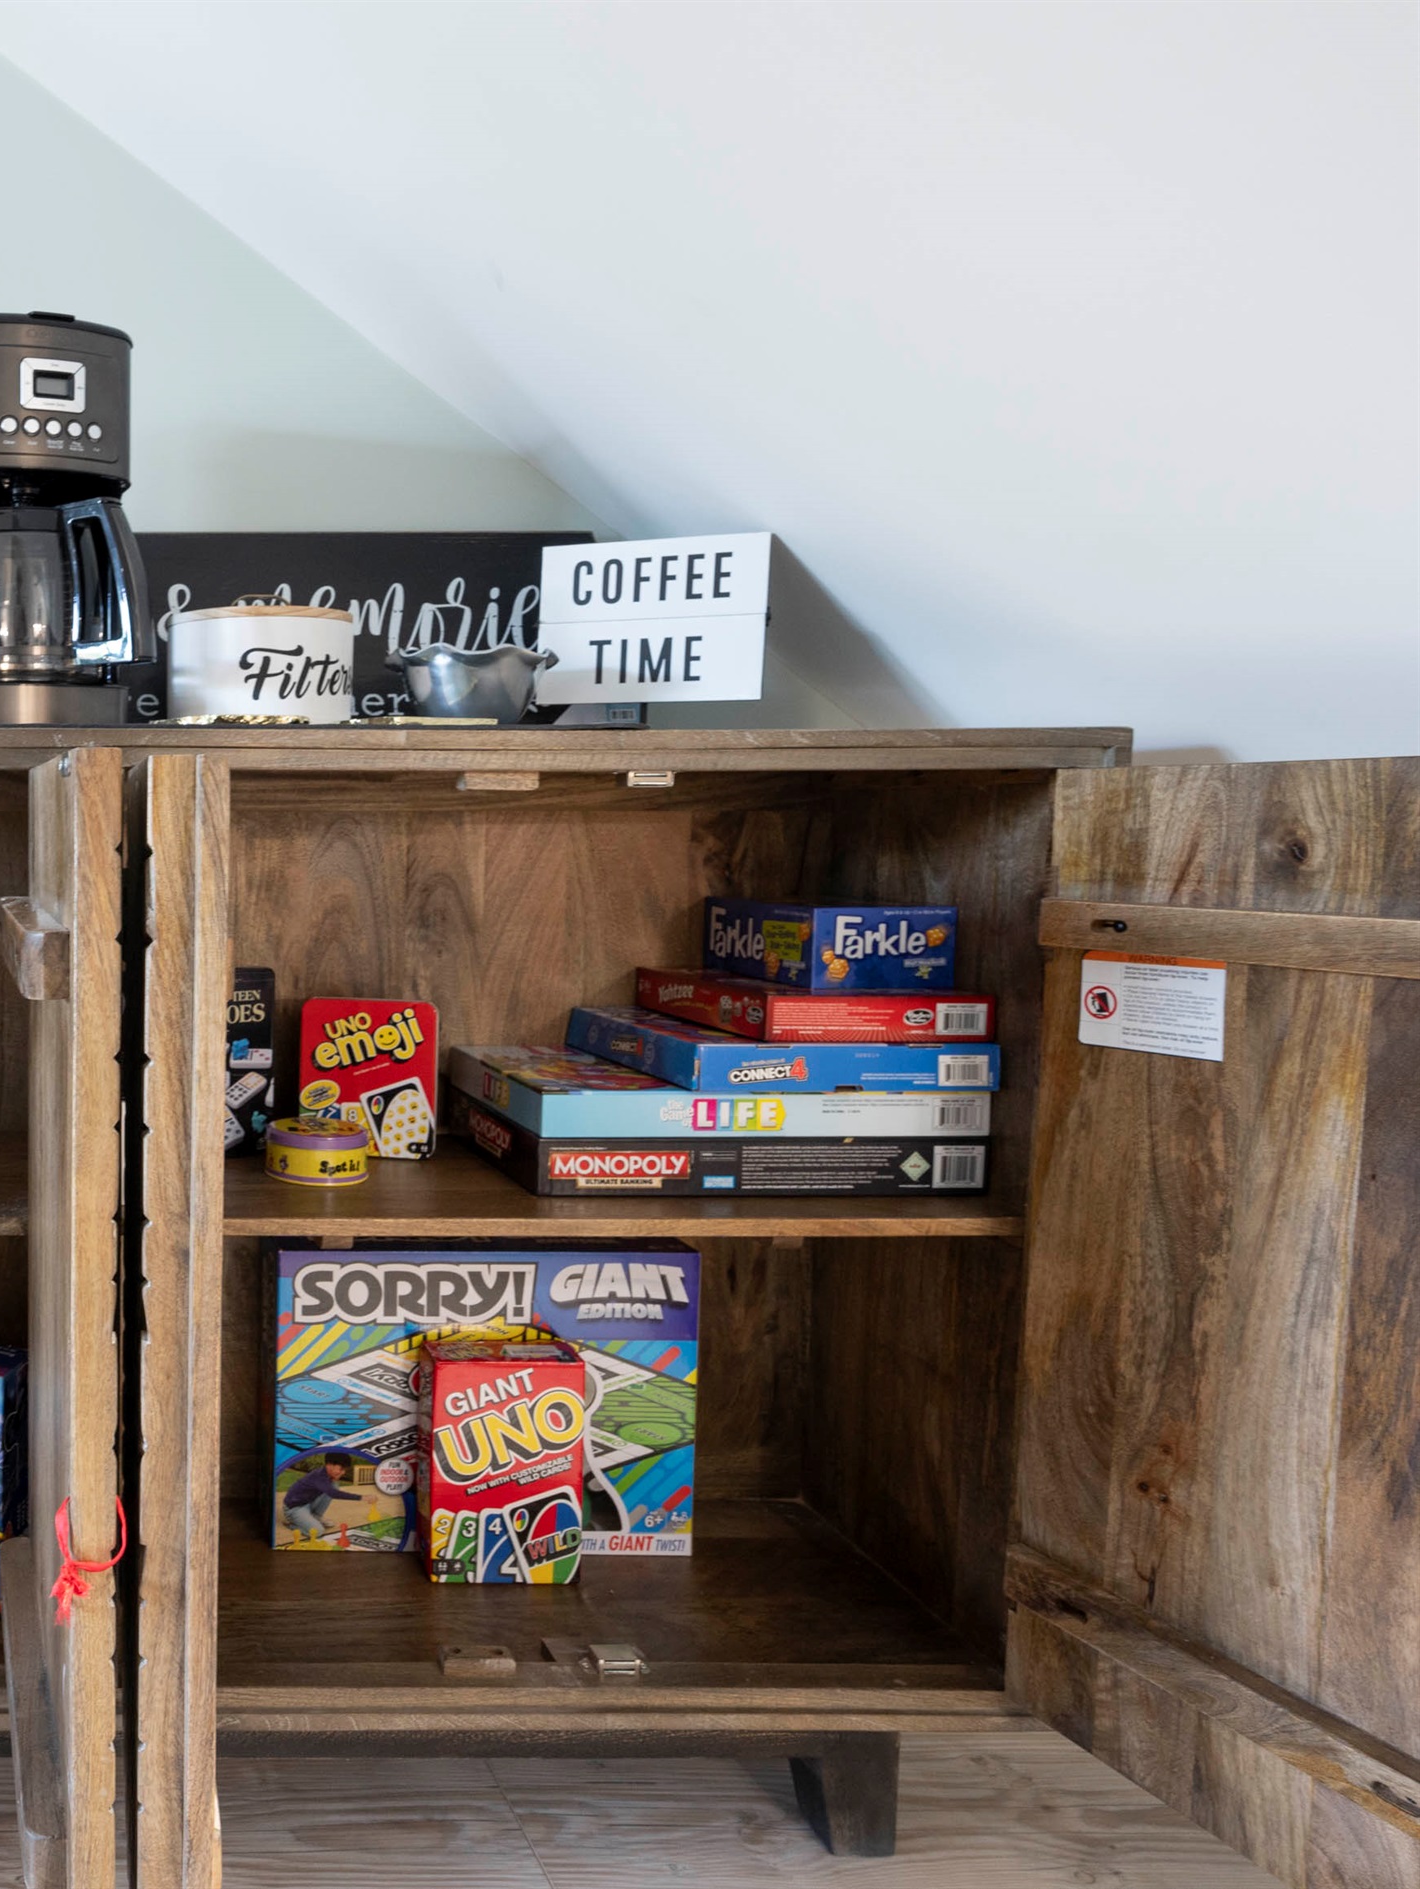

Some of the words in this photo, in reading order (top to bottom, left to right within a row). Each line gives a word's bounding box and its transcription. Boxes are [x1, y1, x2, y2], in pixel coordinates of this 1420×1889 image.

[572, 551, 733, 606] COFFEE
[589, 635, 703, 685] TIME
[709, 906, 765, 960] Farkle
[835, 915, 926, 959] Farkle
[233, 990, 261, 1002] TEEN
[225, 1003, 266, 1024] OES
[324, 1012, 372, 1039] UNO
[730, 1065, 791, 1083] CONNECT
[790, 1057, 806, 1080] 4
[348, 1109, 357, 1122] 8
[697, 1101, 778, 1128] LIFE
[317, 1159, 347, 1176] Spot
[349, 1159, 360, 1172] it!
[554, 1155, 686, 1175] MONOPOLY
[299, 1268, 526, 1319] SORRY!
[549, 1263, 689, 1304] GIANT
[576, 1303, 663, 1320] EDITION
[297, 1384, 330, 1399] START
[444, 1367, 534, 1417] GIANT
[435, 1389, 585, 1482] UNO
[467, 1482, 488, 1495] NOW
[489, 1476, 510, 1490] WITH
[510, 1454, 574, 1480] CUSTOMIZABLE
[519, 1473, 540, 1485] WILD
[541, 1463, 571, 1478] CARDS!
[435, 1518, 450, 1534] 2
[462, 1521, 476, 1537] 3
[488, 1518, 502, 1534] 4
[644, 1514, 663, 1528] 6+
[527, 1529, 580, 1560] WILD
[581, 1539, 596, 1551] ITH
[599, 1539, 605, 1550] A
[608, 1535, 654, 1551] GIANT
[656, 1539, 686, 1552] TWIST!
